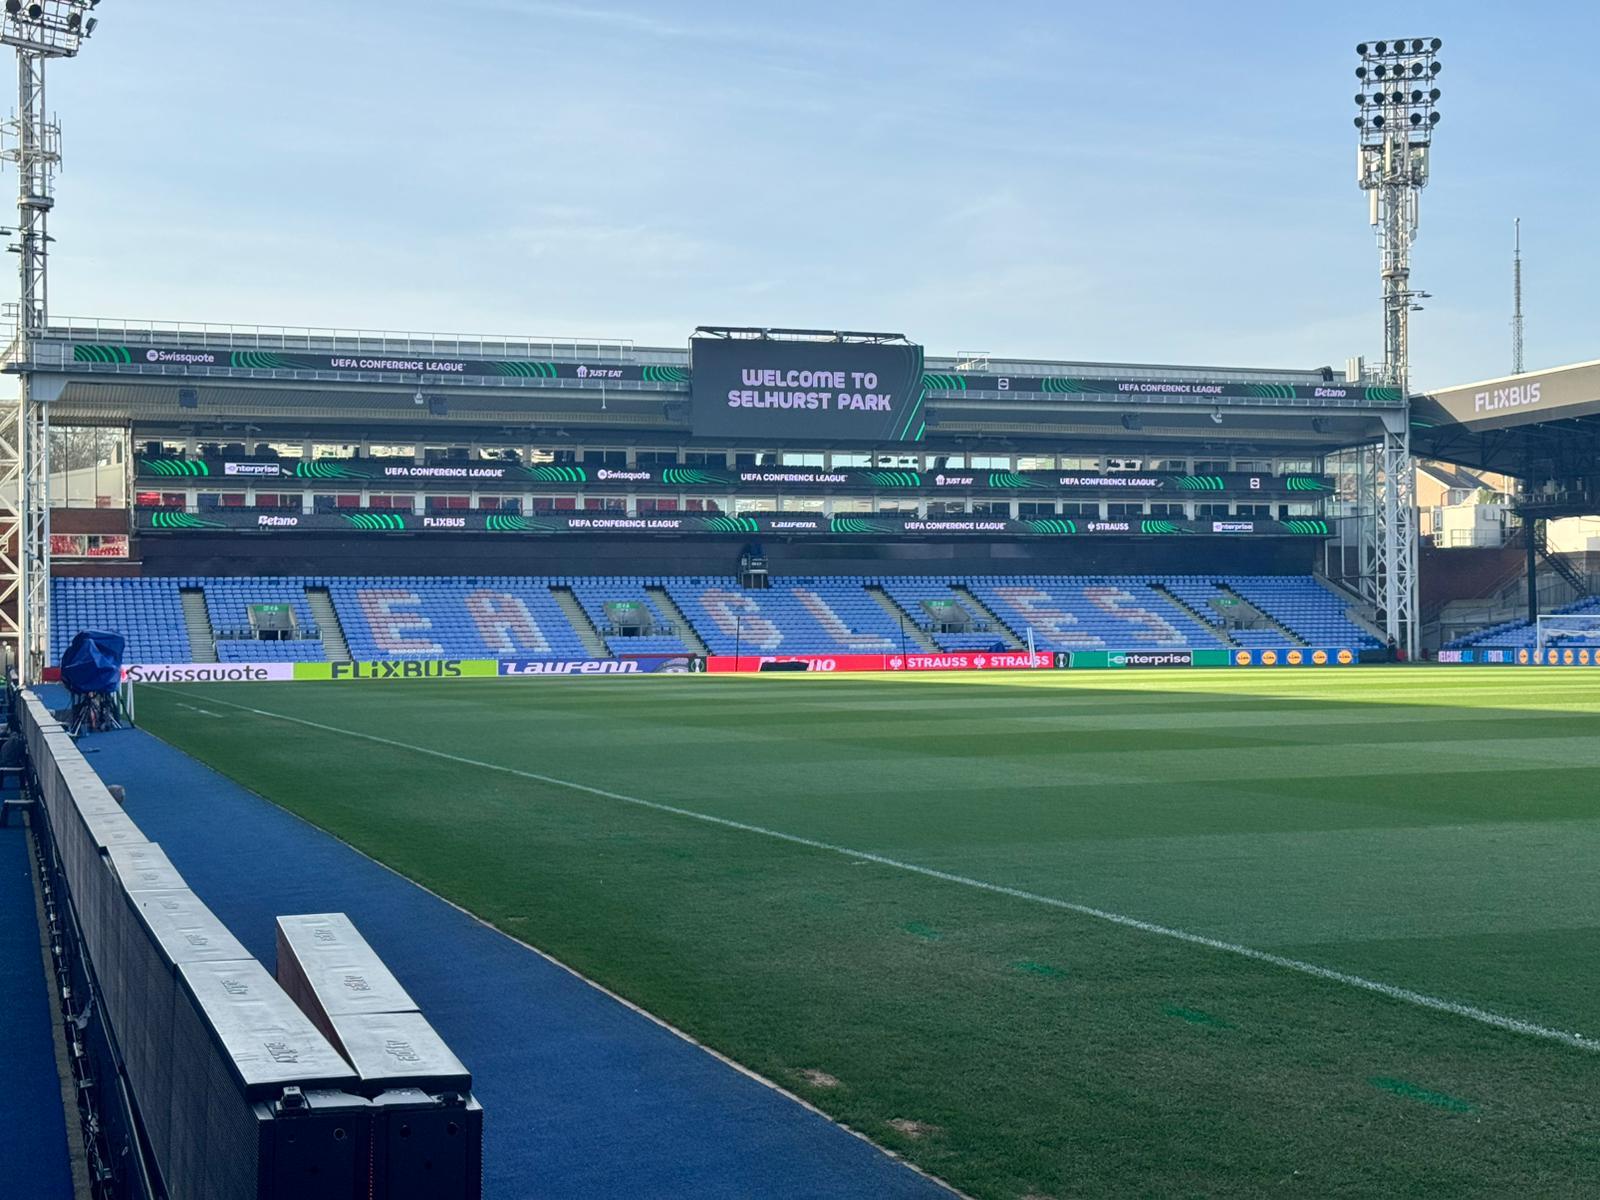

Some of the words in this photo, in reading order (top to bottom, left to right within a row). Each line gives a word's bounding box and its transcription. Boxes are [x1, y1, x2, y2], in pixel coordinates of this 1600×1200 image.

[159, 351, 215, 365] Swissquote
[331, 358, 358, 369] UEFA
[359, 359, 424, 371] CONFERENCE
[426, 361, 464, 372] LEAGUE
[589, 369, 608, 378] JUST
[608, 370, 623, 378] EAT
[742, 368, 846, 389] WELCOME
[851, 372, 878, 390] TO
[1118, 383, 1140, 393] UEFA
[1140, 384, 1190, 394] CONFERENCE
[1191, 385, 1222, 395] LEAGUE
[1315, 387, 1347, 398] Betano
[728, 390, 832, 410] SELHURST
[838, 393, 892, 411] PARK
[385, 467, 408, 477] UEFA
[410, 467, 467, 477] CONFERENCE
[469, 468, 503, 478] LEAGUE
[607, 469, 650, 481] Swissquote
[741, 473, 763, 482] UEFA
[763, 473, 814, 483] CONFERENCE
[1060, 478, 1080, 486] UEFA
[1081, 478, 1128, 487] CONFERENCE
[258, 515, 298, 526] Betano
[568, 519, 591, 528] UEFA
[592, 519, 646, 529] CONFERENCE
[904, 522, 926, 531] UEFA
[927, 522, 974, 531] CONFERENCE
[1096, 522, 1129, 531] STRAUSS
[907, 656, 968, 667] STRAUSS
[1109, 653, 1191, 666] enterprise
